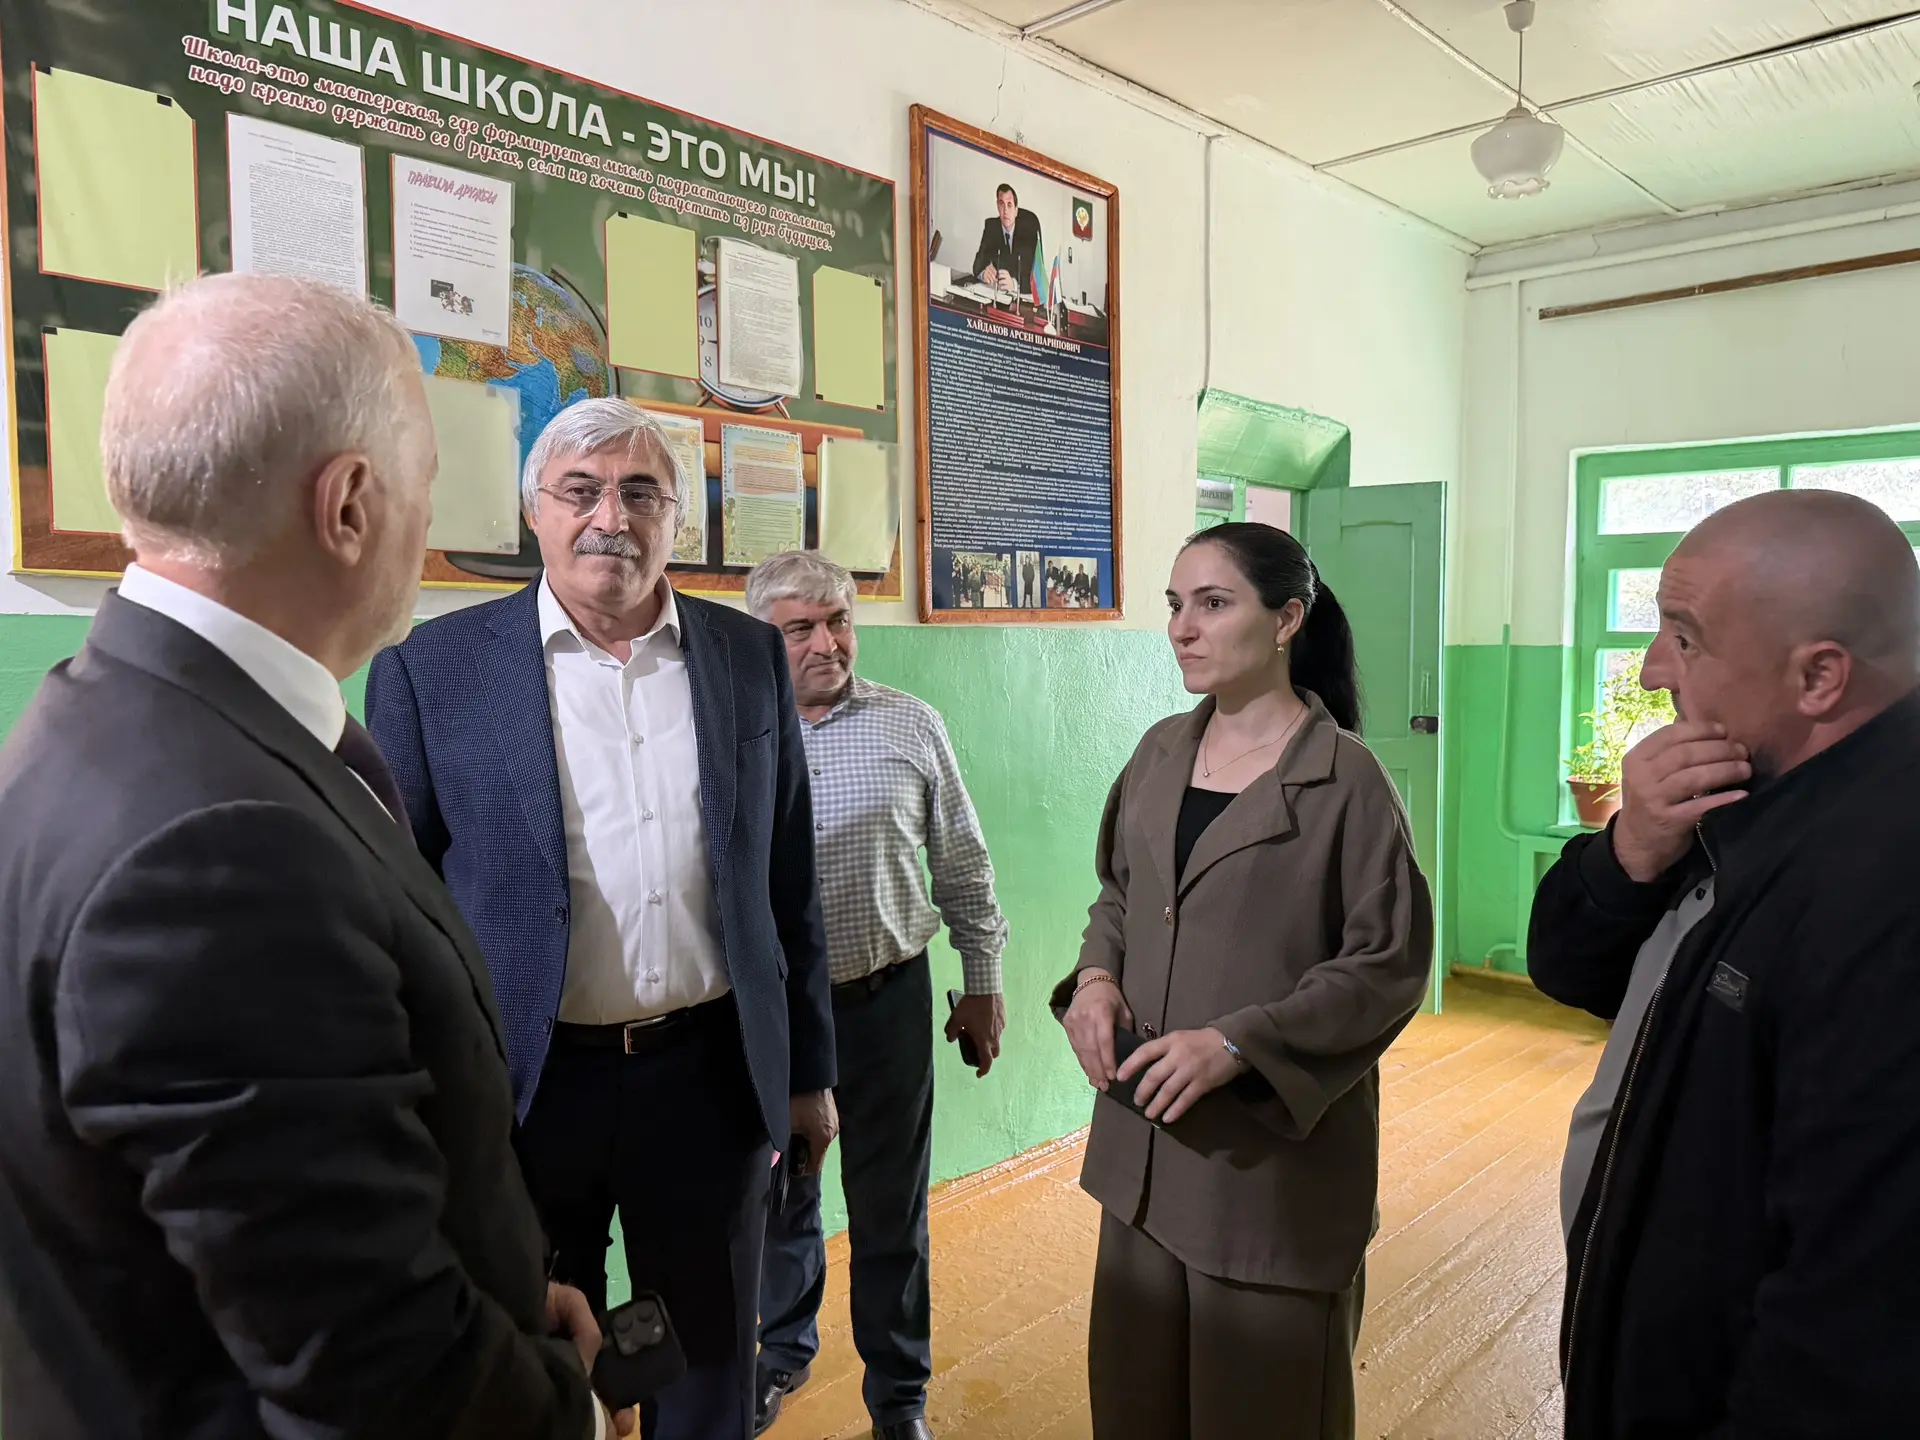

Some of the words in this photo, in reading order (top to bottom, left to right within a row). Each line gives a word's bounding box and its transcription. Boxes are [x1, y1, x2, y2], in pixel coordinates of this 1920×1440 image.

[182, 35, 309, 86] Школа-это
[314, 77, 445, 128] мастерская,
[449, 115, 479, 135] где
[482, 122, 601, 168] формируется
[602, 159, 654, 183] мысль
[657, 174, 767, 215] подрастающего
[769, 206, 835, 237] поколения,
[188, 65, 246, 94] надо
[251, 81, 326, 114] крепко
[332, 103, 426, 140] держать
[430, 131, 450, 147] ее
[454, 134, 465, 151] в
[468, 141, 523, 169] руках,
[527, 157, 566, 179] если
[568, 167, 588, 184] не
[590, 173, 645, 200] хочешь
[648, 187, 731, 223] выпустить
[733, 213, 749, 231] из
[751, 218, 776, 237] рук
[778, 223, 833, 252] будущее.
[216, 0, 407, 86] НАША
[422, 51, 612, 147] ШКОЛА
[621, 129, 636, 144] -
[646, 121, 727, 179] ЭТО
[739, 150, 816, 208] МЫ!
[407, 170, 455, 194] ПРАВИЛА
[453, 183, 498, 205] ДРУЖБЫ
[704, 355, 713, 368] 8
[966, 317, 1008, 338] ХАЙДАКОВ
[1009, 328, 1034, 343] АРСЕН
[1034, 333, 1081, 354] ШАРИПОВИЧ
